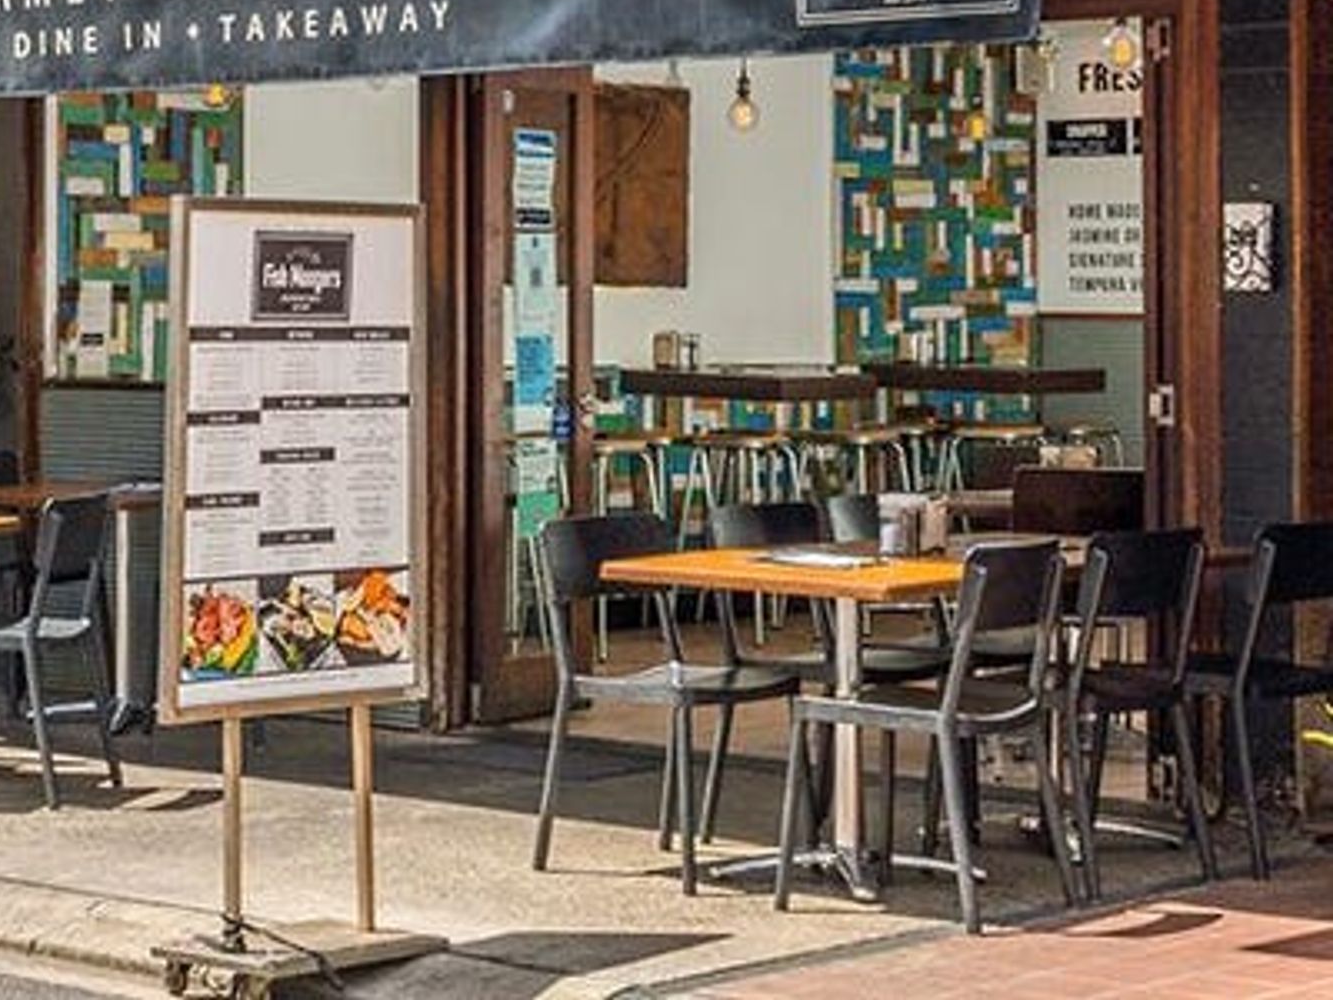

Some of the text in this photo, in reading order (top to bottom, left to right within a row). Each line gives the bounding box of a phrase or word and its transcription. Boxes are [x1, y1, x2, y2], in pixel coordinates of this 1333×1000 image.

[14, 0, 450, 59] DINE IN TAKEAWAY
